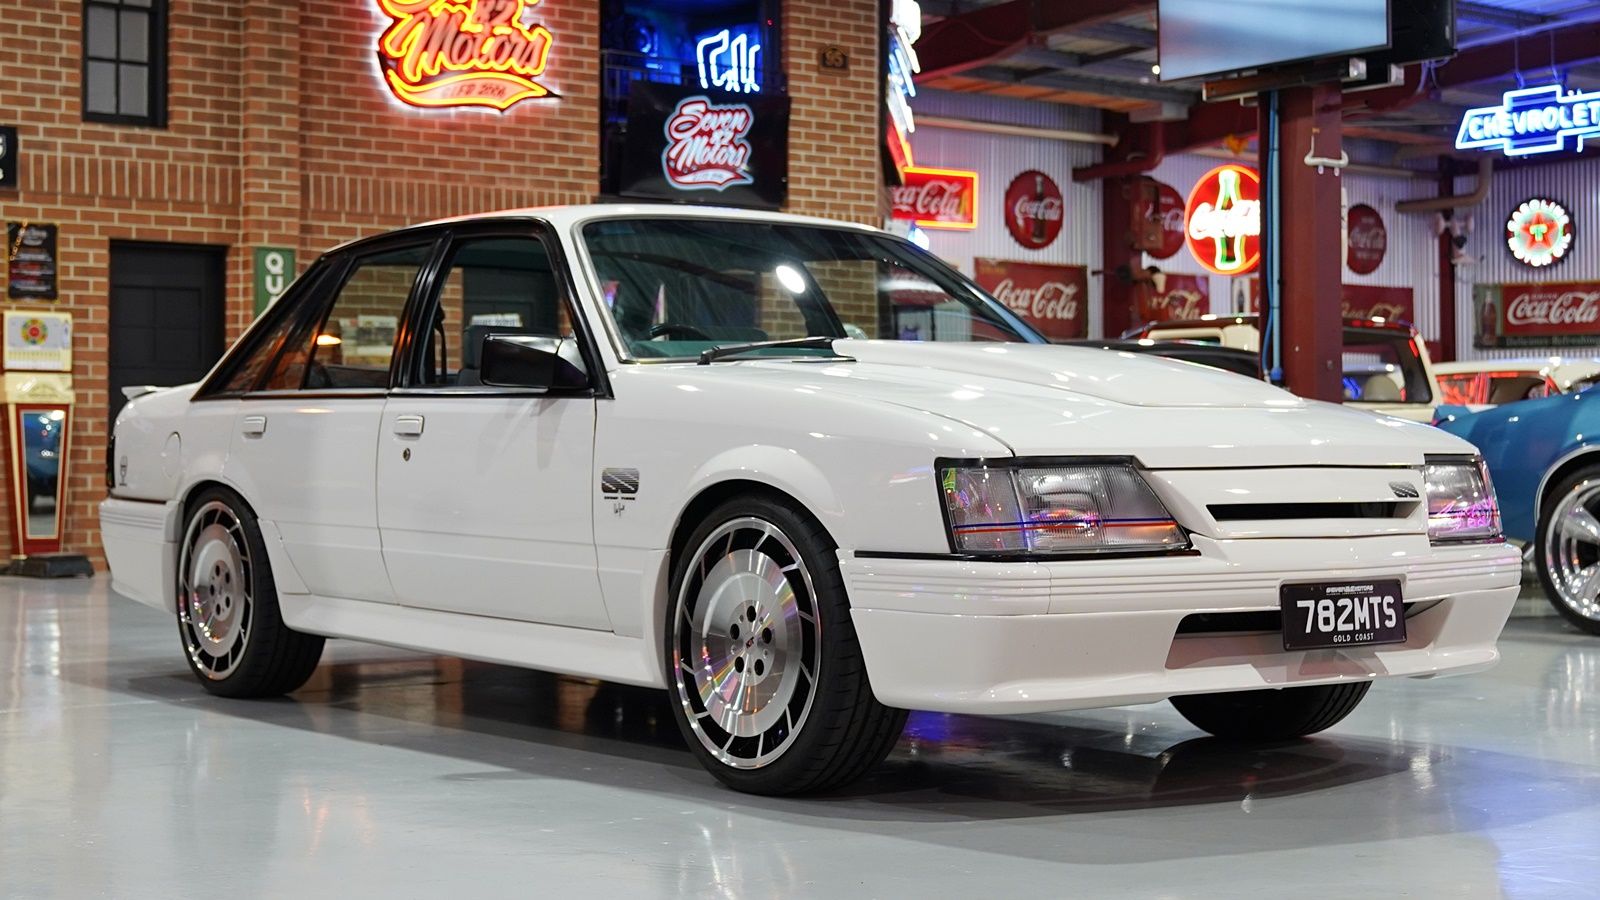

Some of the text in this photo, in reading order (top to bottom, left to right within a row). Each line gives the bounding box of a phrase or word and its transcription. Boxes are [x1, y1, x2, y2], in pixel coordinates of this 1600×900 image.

[388, 11, 548, 80] Motors
[671, 101, 747, 140] Seven
[1468, 101, 1600, 140] CHEVROLET
[668, 135, 747, 171] Motors
[1507, 291, 1600, 325] Coca-Cola
[1296, 595, 1397, 634] 782MTS
[1333, 632, 1374, 643] GOLD COAST
